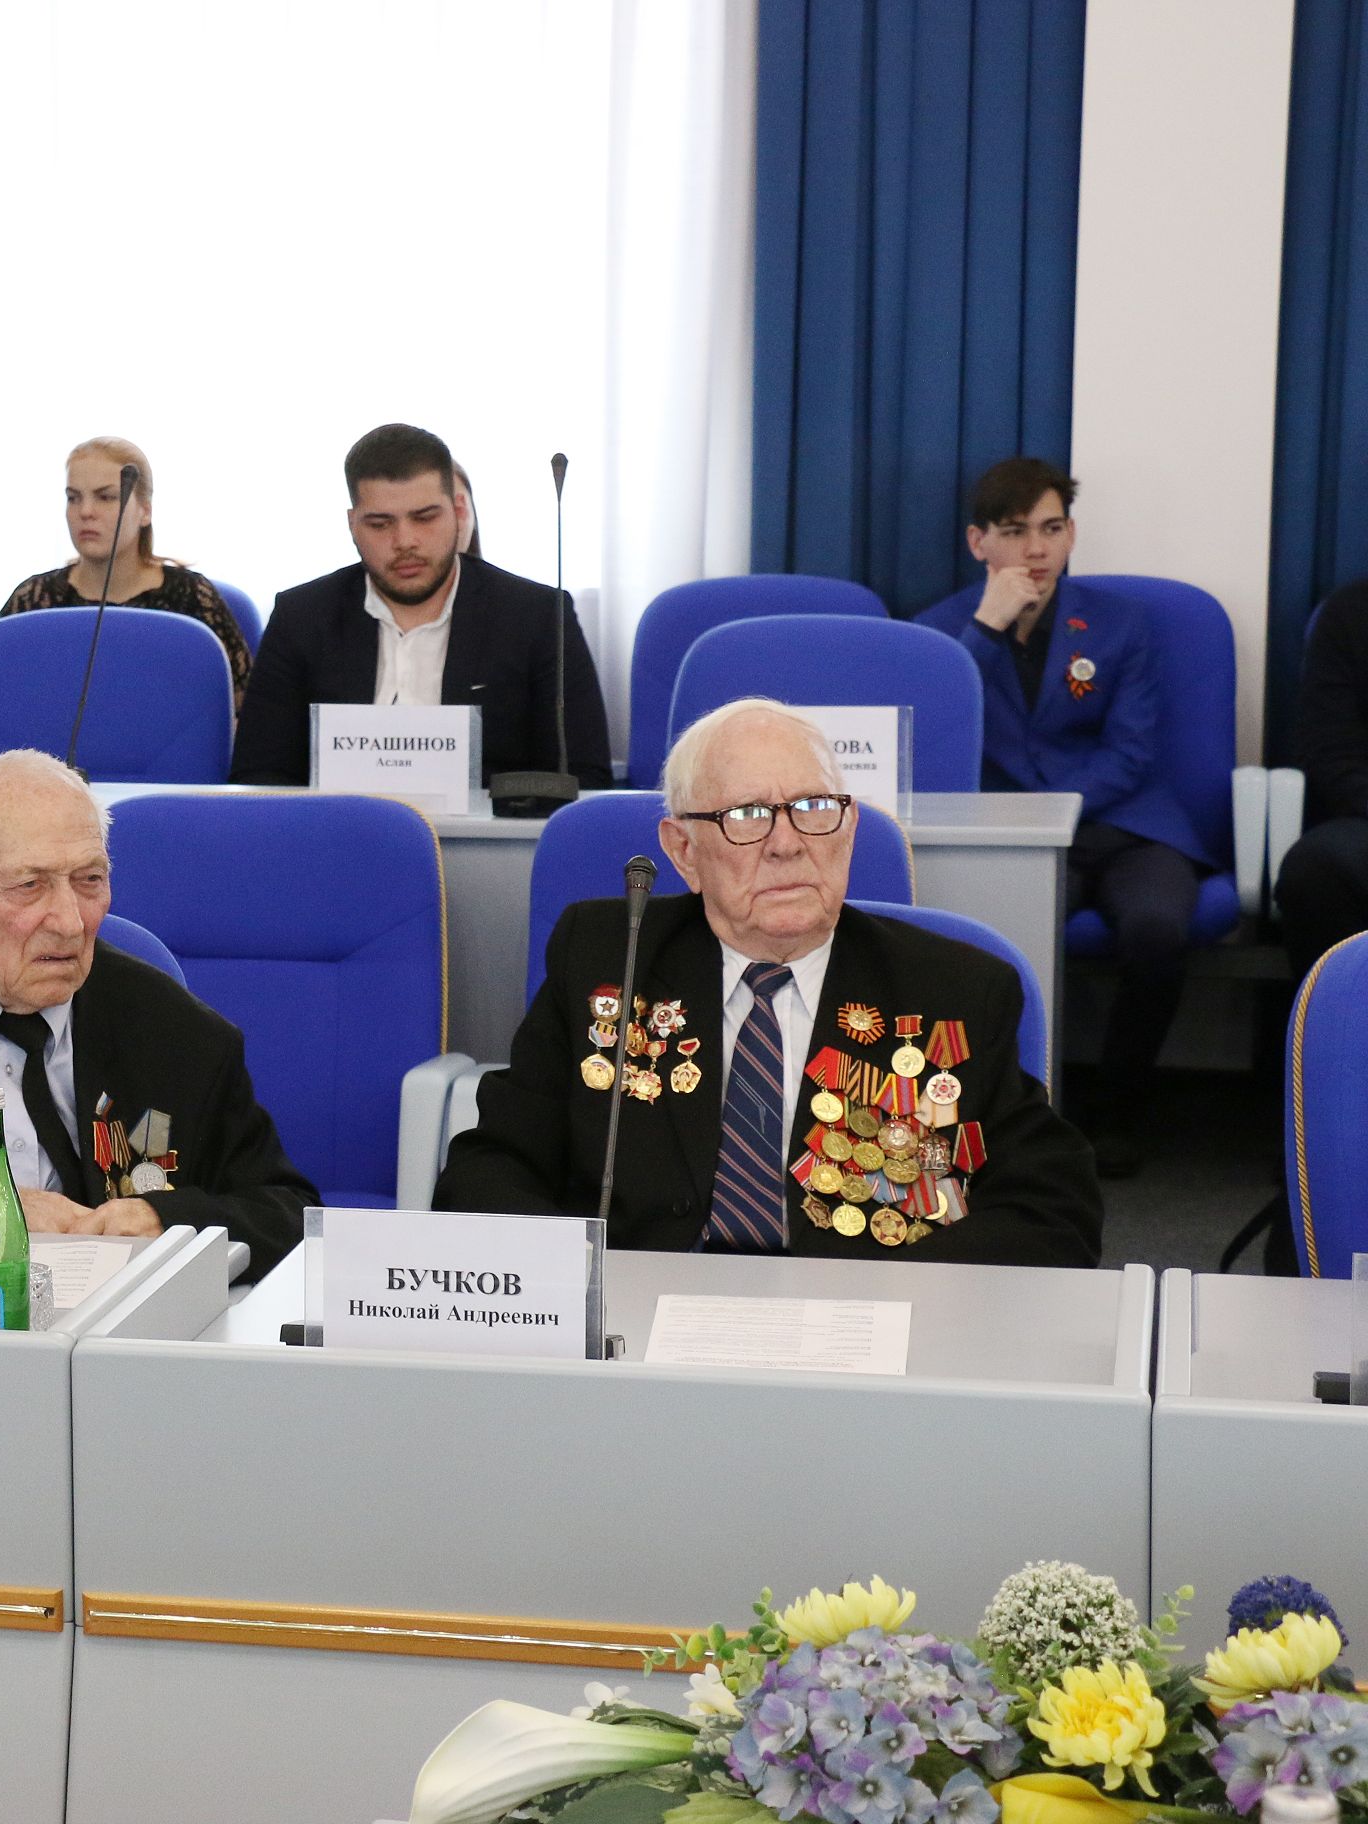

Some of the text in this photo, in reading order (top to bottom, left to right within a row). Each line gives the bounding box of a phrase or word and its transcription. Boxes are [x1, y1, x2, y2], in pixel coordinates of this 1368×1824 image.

[333, 736, 457, 752] КУРАШИНОВ
[376, 757, 412, 768] Аслан
[386, 1267, 523, 1297] БУЧКОВ
[348, 1299, 559, 1328] Николай Андреевич
